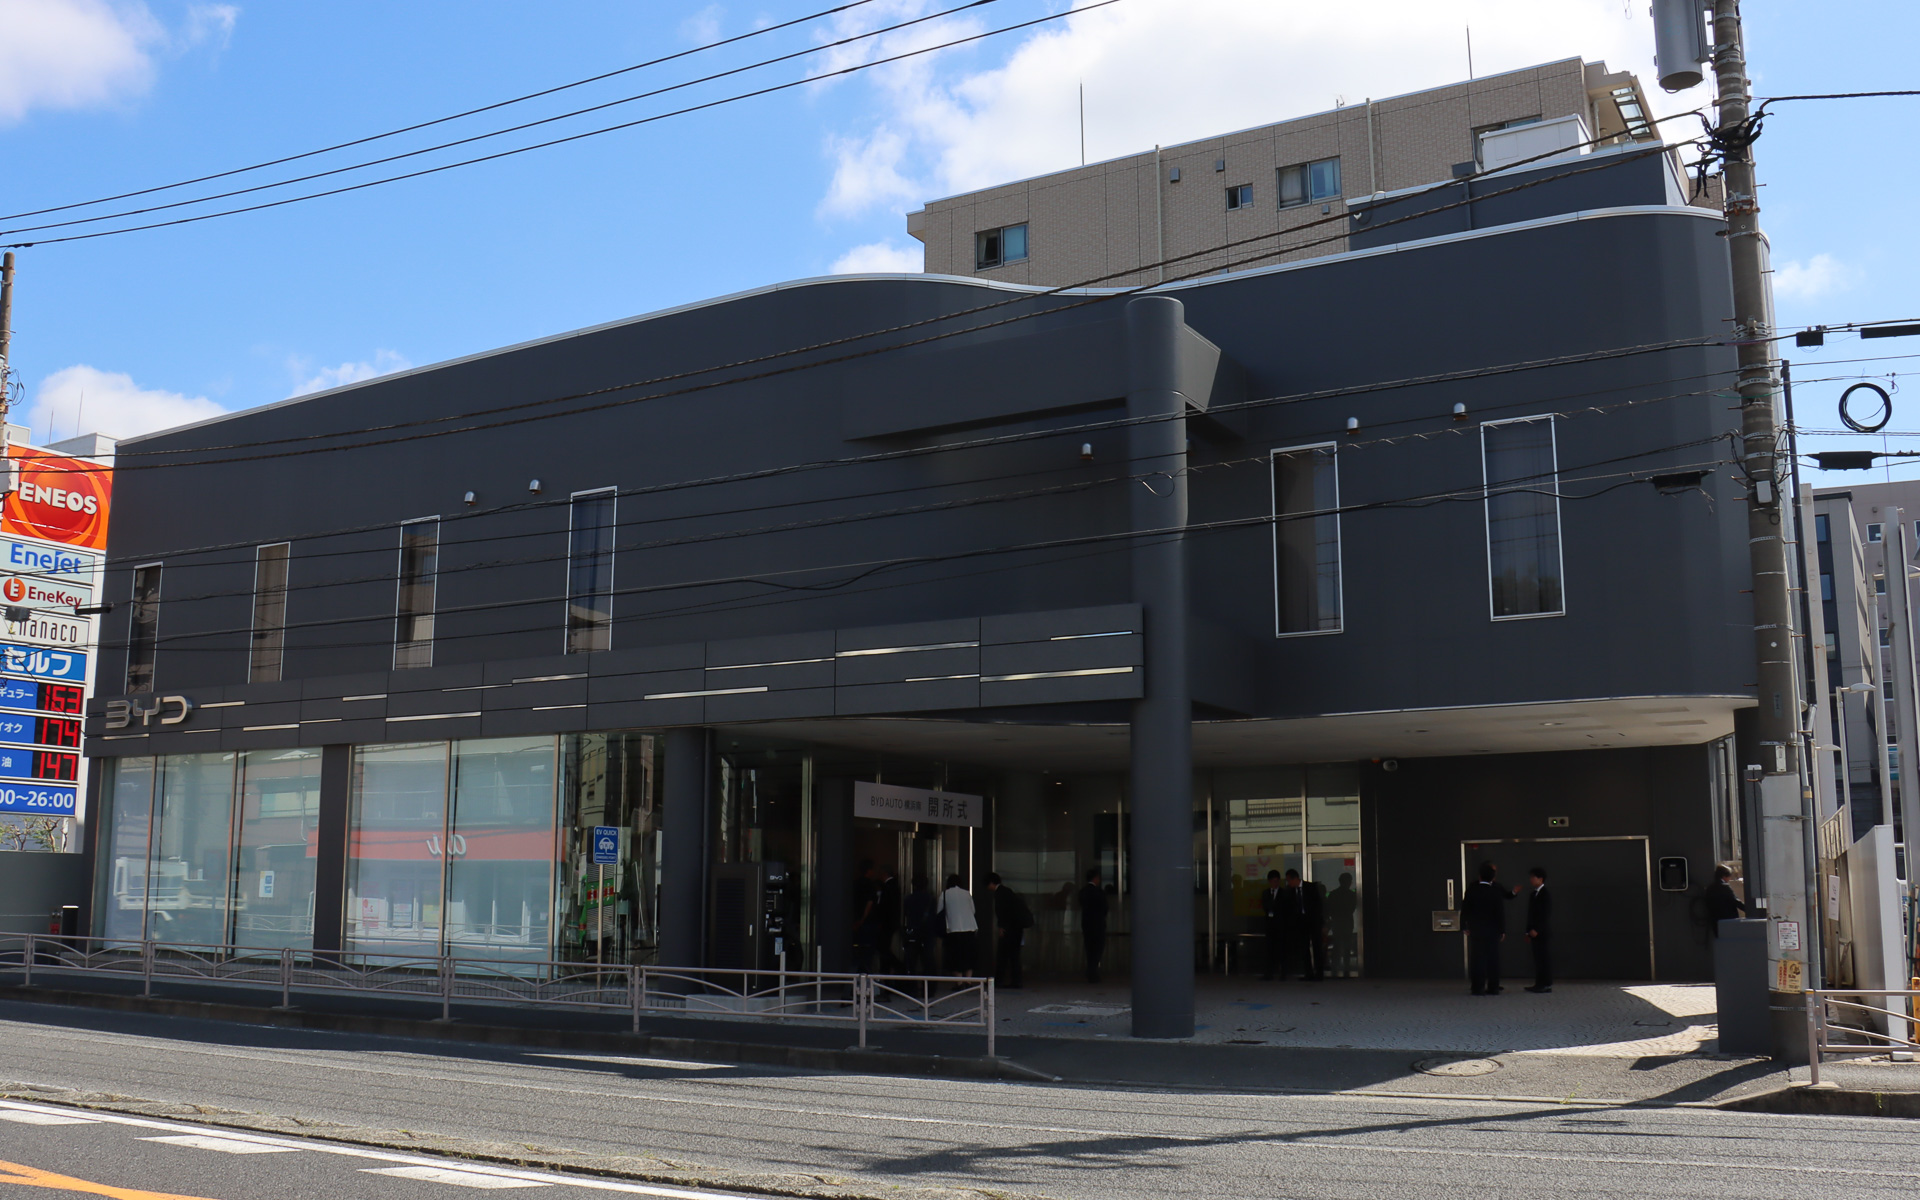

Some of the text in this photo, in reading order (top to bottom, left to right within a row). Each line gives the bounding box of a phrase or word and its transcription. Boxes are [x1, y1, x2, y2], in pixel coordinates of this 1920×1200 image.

[19, 481, 97, 515] ENEOS
[28, 586, 82, 609] EneKey
[19, 620, 77, 643] nanaco
[4, 646, 72, 676] セルフ
[44, 685, 82, 714] 163
[105, 695, 188, 729] BYD
[41, 718, 79, 747] 174
[1, 752, 77, 781] 油 147
[870, 796, 885, 807] BYD
[885, 798, 903, 809] AUTO
[928, 796, 968, 820] 開所式
